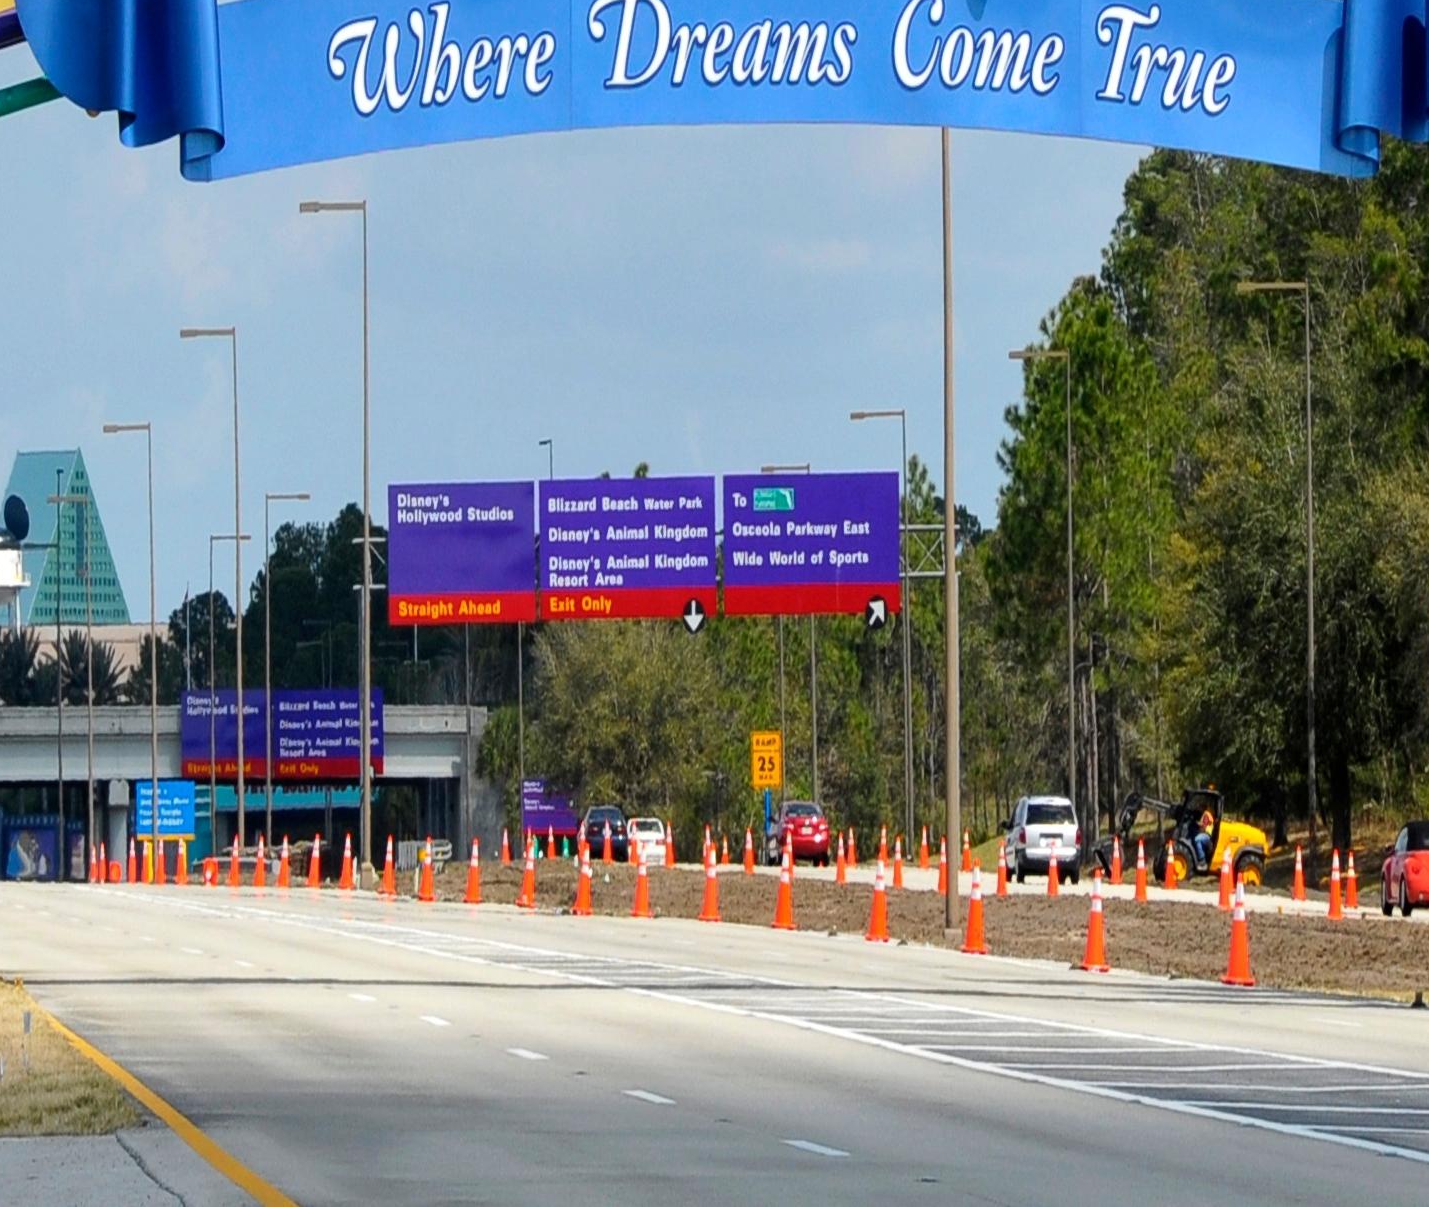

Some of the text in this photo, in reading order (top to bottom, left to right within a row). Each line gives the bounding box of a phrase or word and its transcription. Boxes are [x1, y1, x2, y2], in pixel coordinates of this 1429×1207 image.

[328, 2, 556, 116] Where
[1095, 4, 1236, 116] True
[397, 494, 450, 509] Disney's
[548, 496, 703, 513] Blizzard Beach Water Park
[732, 492, 747, 508] To
[397, 506, 514, 526] Hollywood Studios
[548, 524, 708, 544] Disney's Animal Kingdom
[732, 520, 870, 538] Osceola Parkway East
[548, 553, 709, 572] Disney's Animal Kingdom
[732, 549, 869, 567] Wide World of Sports
[549, 571, 624, 587] Resort Area
[398, 599, 501, 619] Straight Ahead
[549, 595, 612, 614] Exit Only
[755, 737, 777, 747] RAMP
[757, 755, 776, 772] 25
